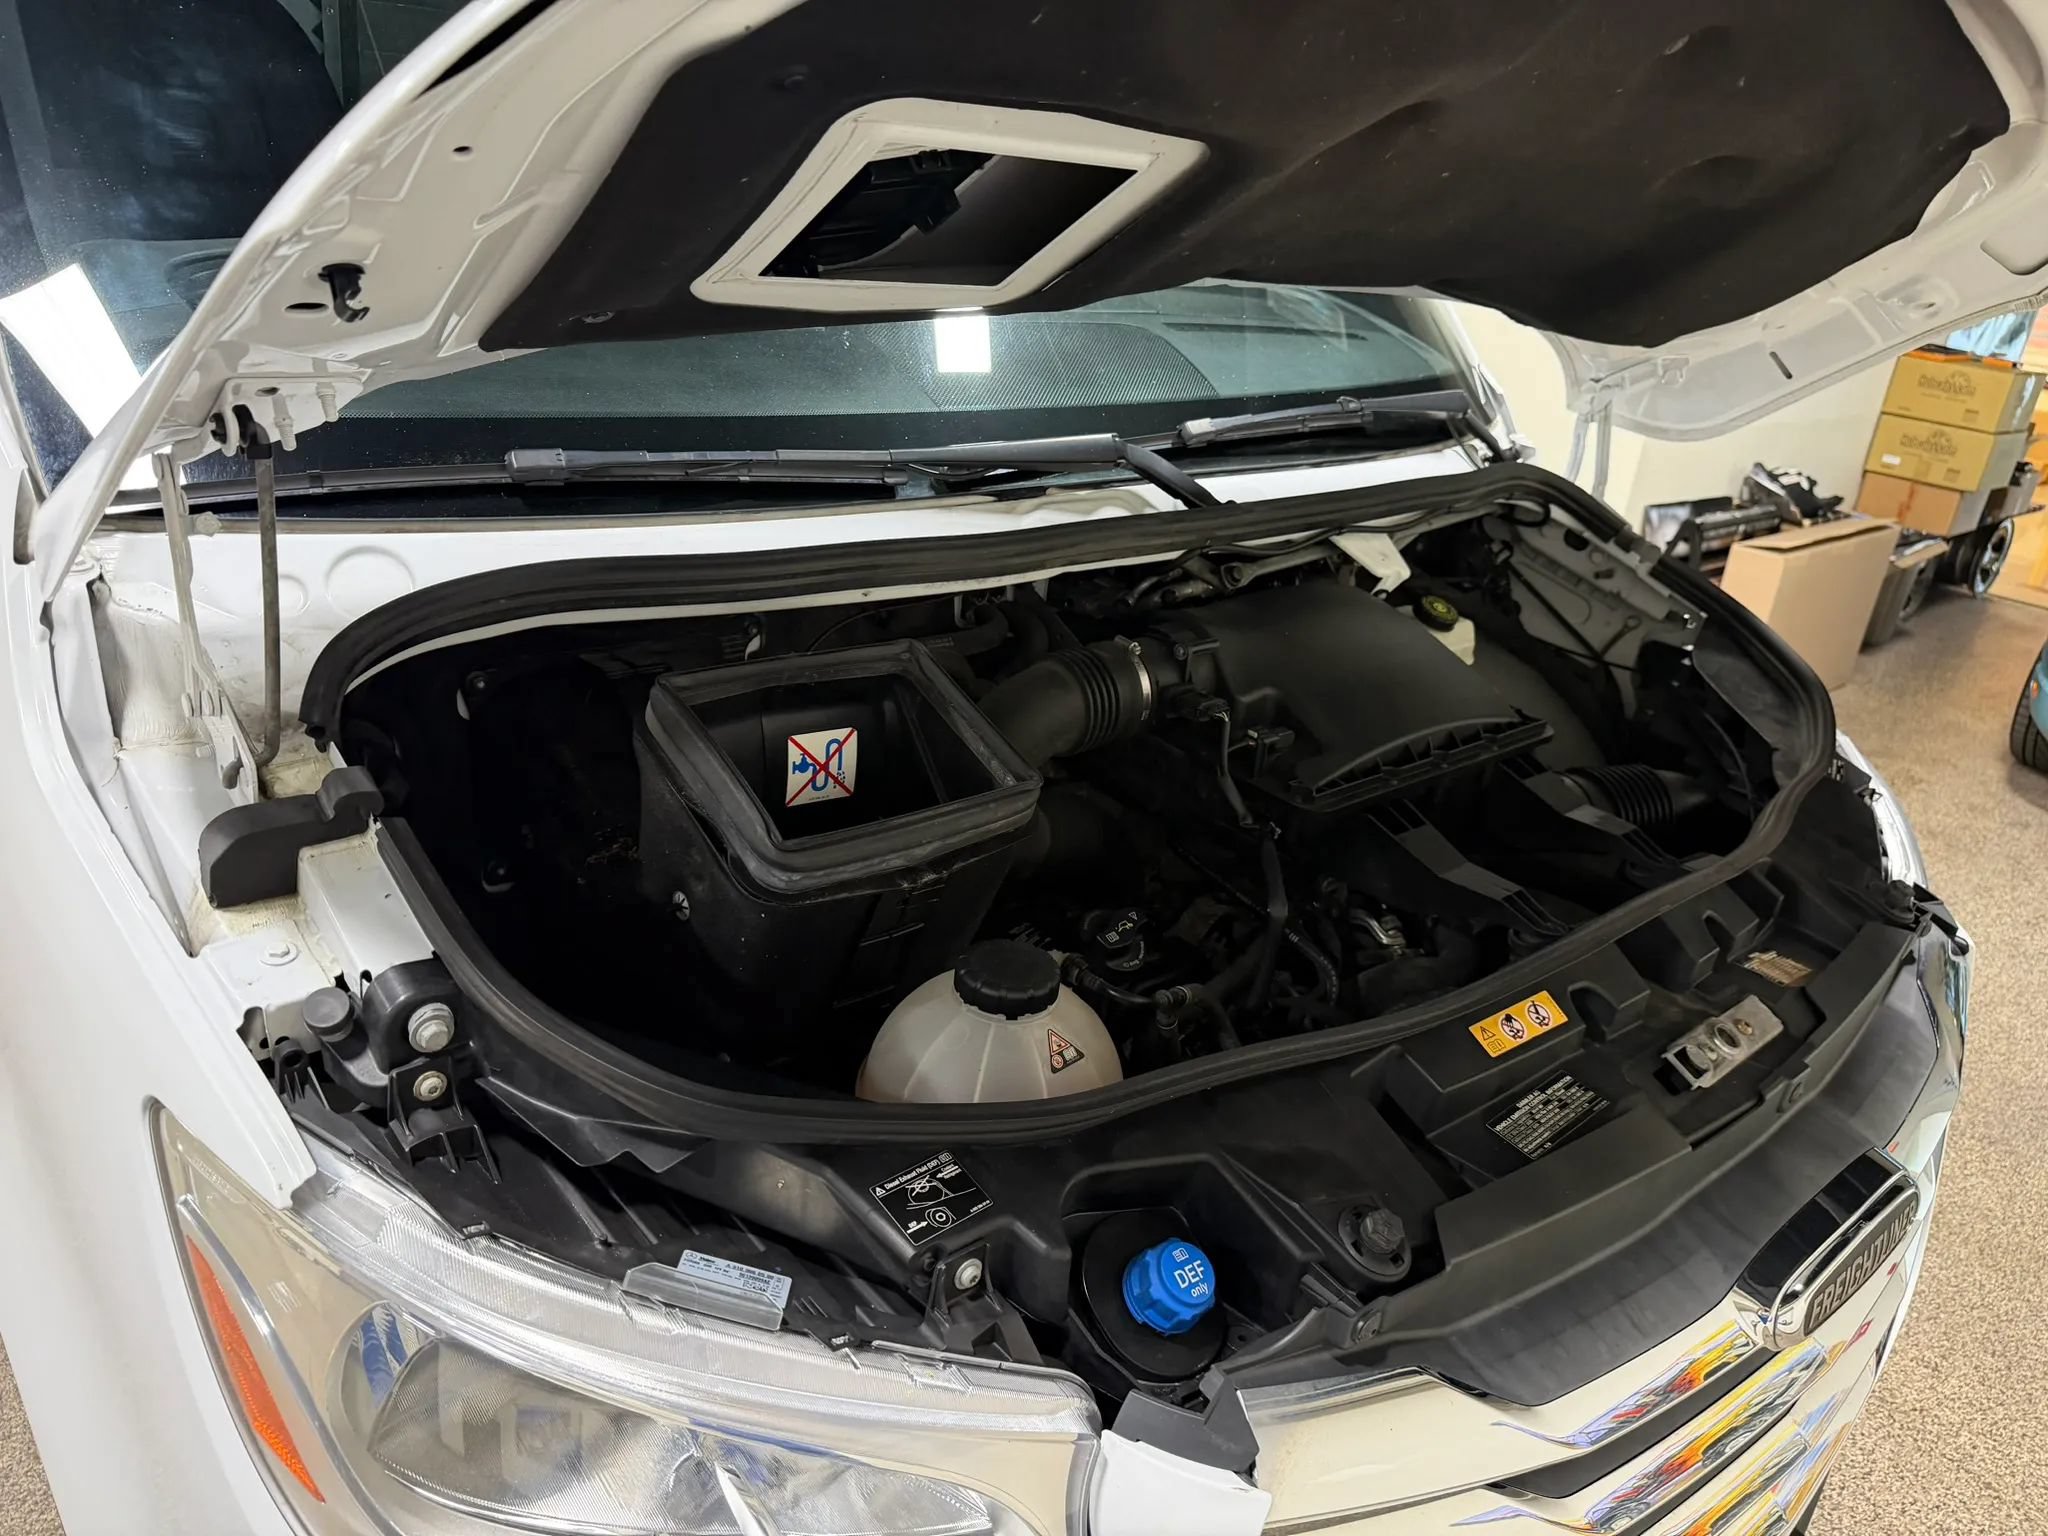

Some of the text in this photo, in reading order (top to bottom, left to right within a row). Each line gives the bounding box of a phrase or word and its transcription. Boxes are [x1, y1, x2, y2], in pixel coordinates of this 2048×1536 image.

[884, 1178, 900, 1190] Diesel
[899, 1170, 918, 1183] Exhaust
[915, 1165, 928, 1174] Fluid
[1173, 1260, 1204, 1289] DEF
[1809, 1201, 1916, 1330] FREIGHTLINER
[1190, 1282, 1210, 1298] only
